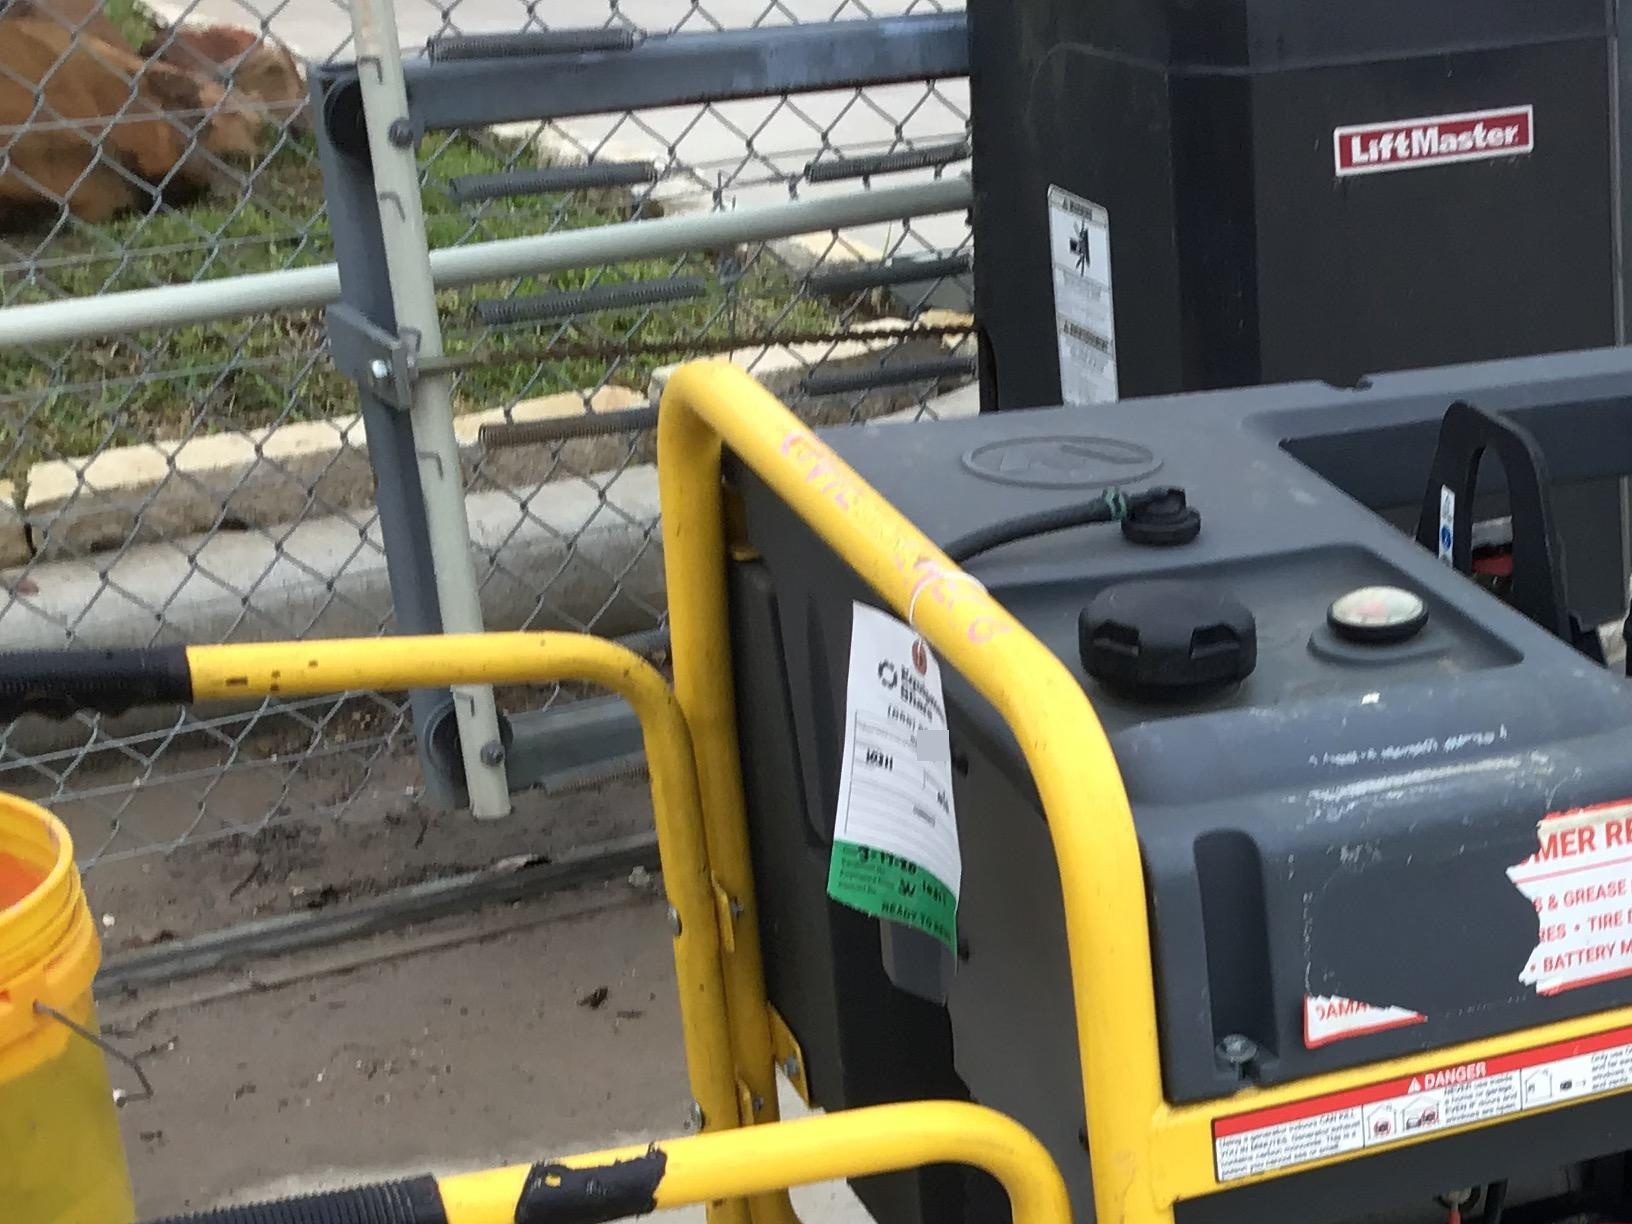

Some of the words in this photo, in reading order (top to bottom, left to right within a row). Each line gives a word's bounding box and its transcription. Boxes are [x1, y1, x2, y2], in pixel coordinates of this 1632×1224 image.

[1351, 121, 1519, 164] LiftMaster
[1547, 893, 1559, 912] &
[1562, 878, 1627, 908] GREASE
[1587, 907, 1625, 932] TIRE
[1542, 941, 1616, 973] BATTERY
[1423, 1061, 1487, 1092] DANGER
